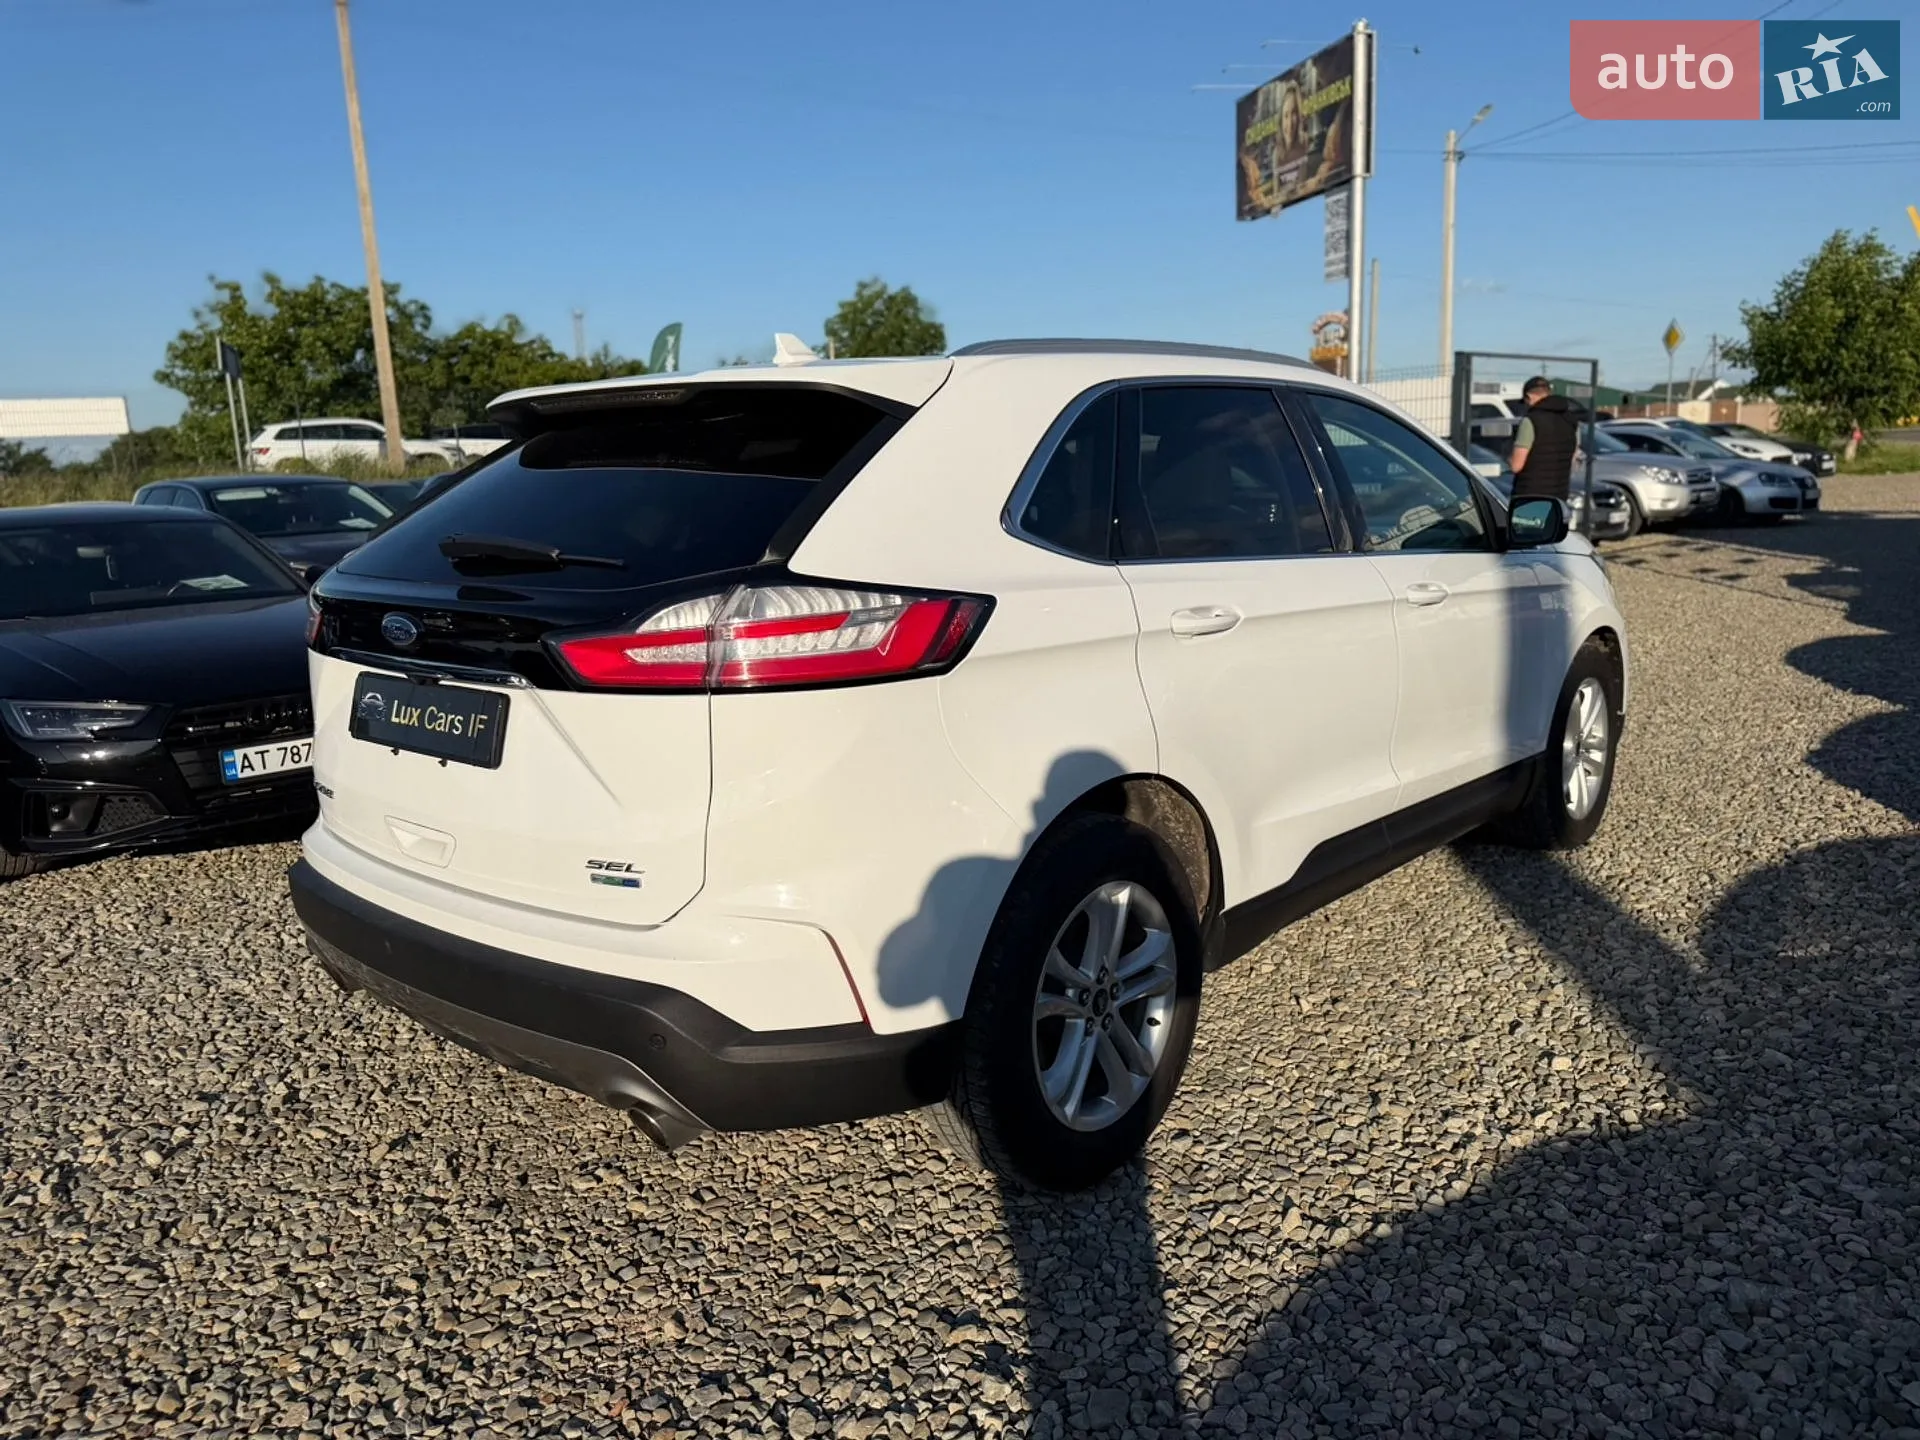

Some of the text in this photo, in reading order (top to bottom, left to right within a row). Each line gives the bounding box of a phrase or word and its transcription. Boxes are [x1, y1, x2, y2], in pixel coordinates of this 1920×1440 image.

[391, 699, 488, 738] Lux Cars IF
[240, 750, 271, 773] AT
[225, 768, 237, 776] UA
[585, 859, 645, 874] SEL
